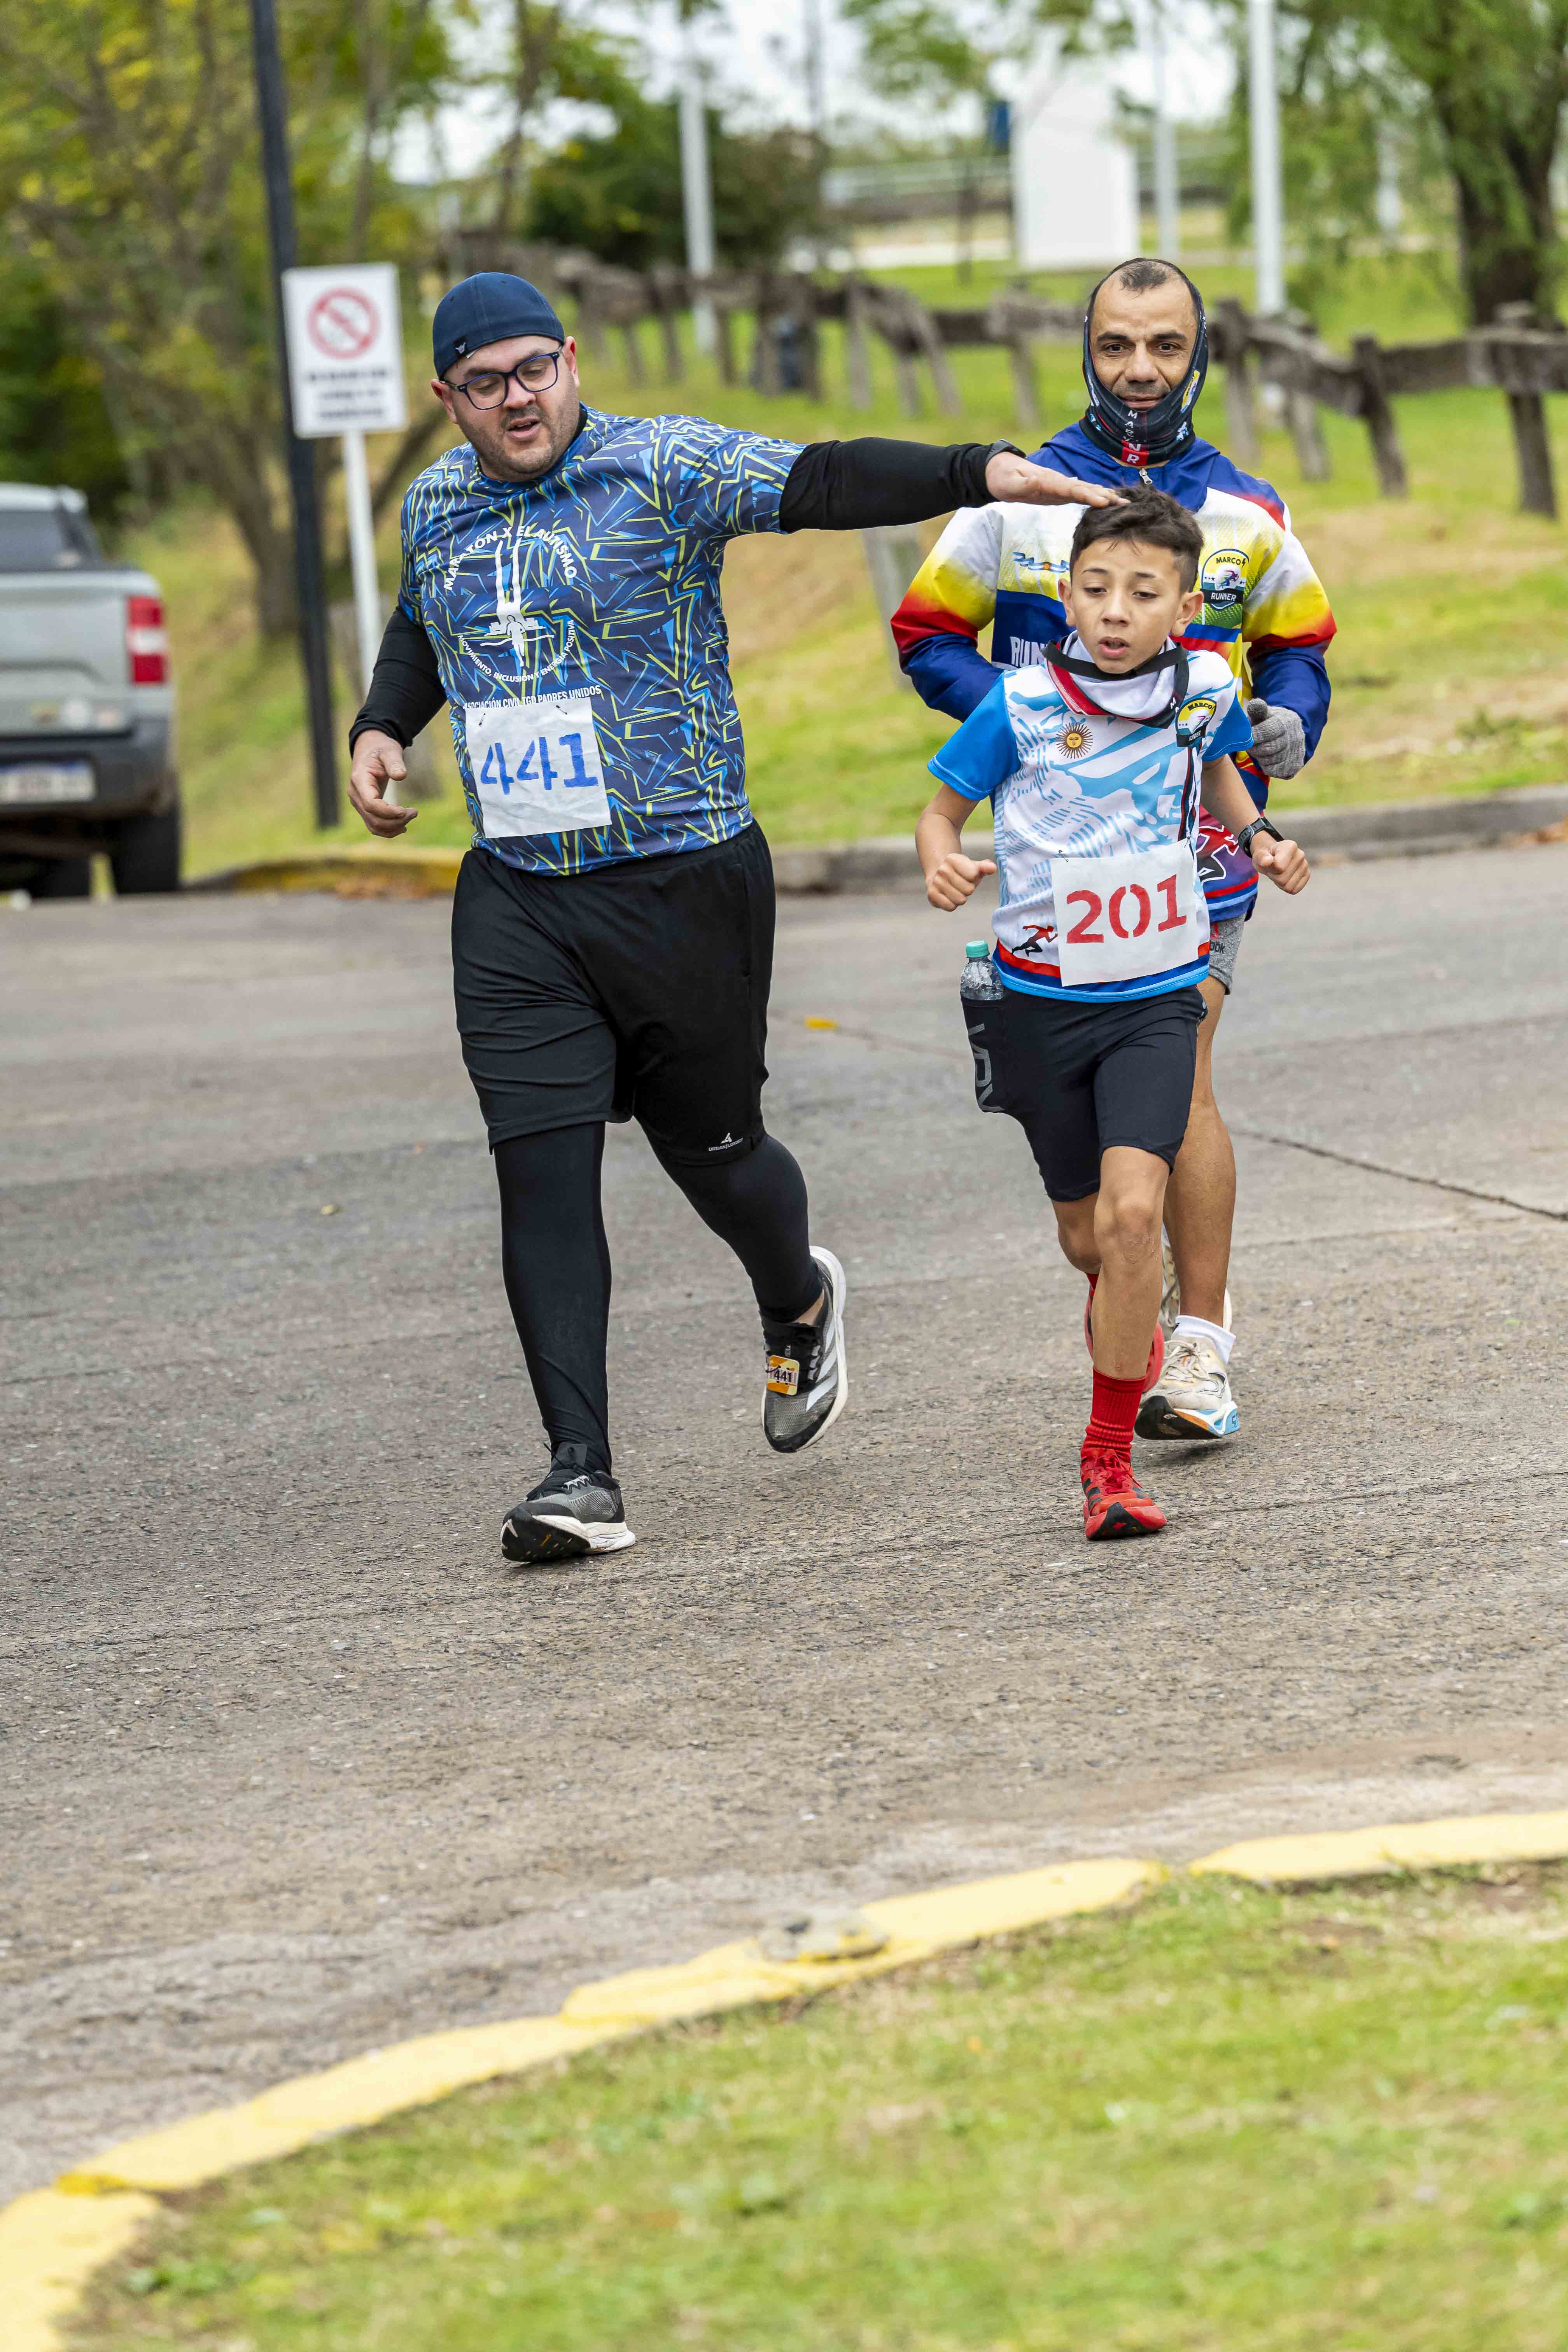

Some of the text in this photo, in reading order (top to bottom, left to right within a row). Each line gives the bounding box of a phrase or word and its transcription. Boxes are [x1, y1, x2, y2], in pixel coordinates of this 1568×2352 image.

[502, 526, 513, 539] X
[517, 525, 530, 537] EL
[533, 528, 577, 578] AUTISMO
[1211, 592, 1237, 602] RUNNER
[457, 635, 492, 677] MOVIMIENTO,
[564, 620, 575, 652] POSITIVA
[1010, 636, 1048, 668] RUN
[537, 691, 568, 703] PADRES
[569, 685, 601, 699] UNIDOS
[480, 733, 599, 795] 441
[1066, 874, 1186, 944] 201
[774, 1369, 792, 1382] 441
